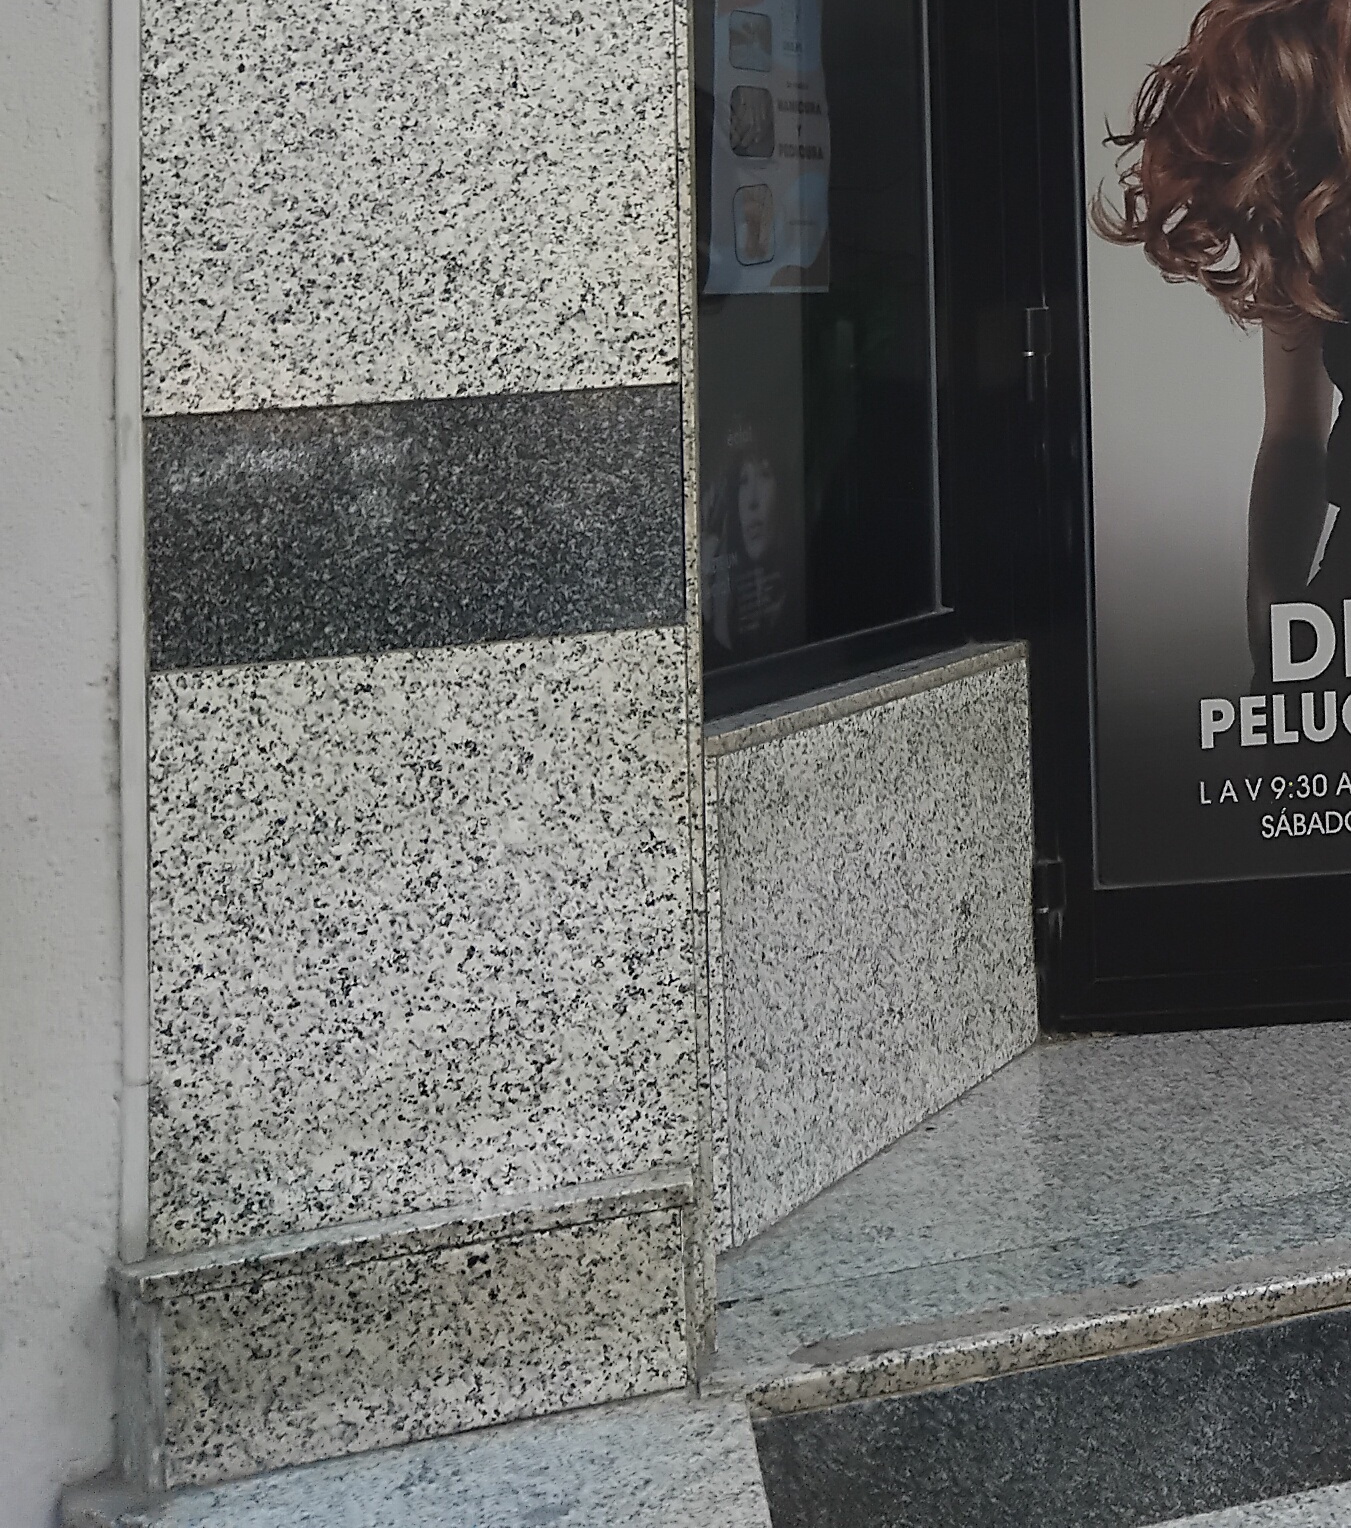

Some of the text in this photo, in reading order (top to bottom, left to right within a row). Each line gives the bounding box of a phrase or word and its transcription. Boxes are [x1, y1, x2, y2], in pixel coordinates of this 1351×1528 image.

[1199, 781, 1213, 806] L
[1219, 778, 1239, 804] A
[1246, 777, 1264, 802] V
[1271, 775, 1329, 800] 9:30
